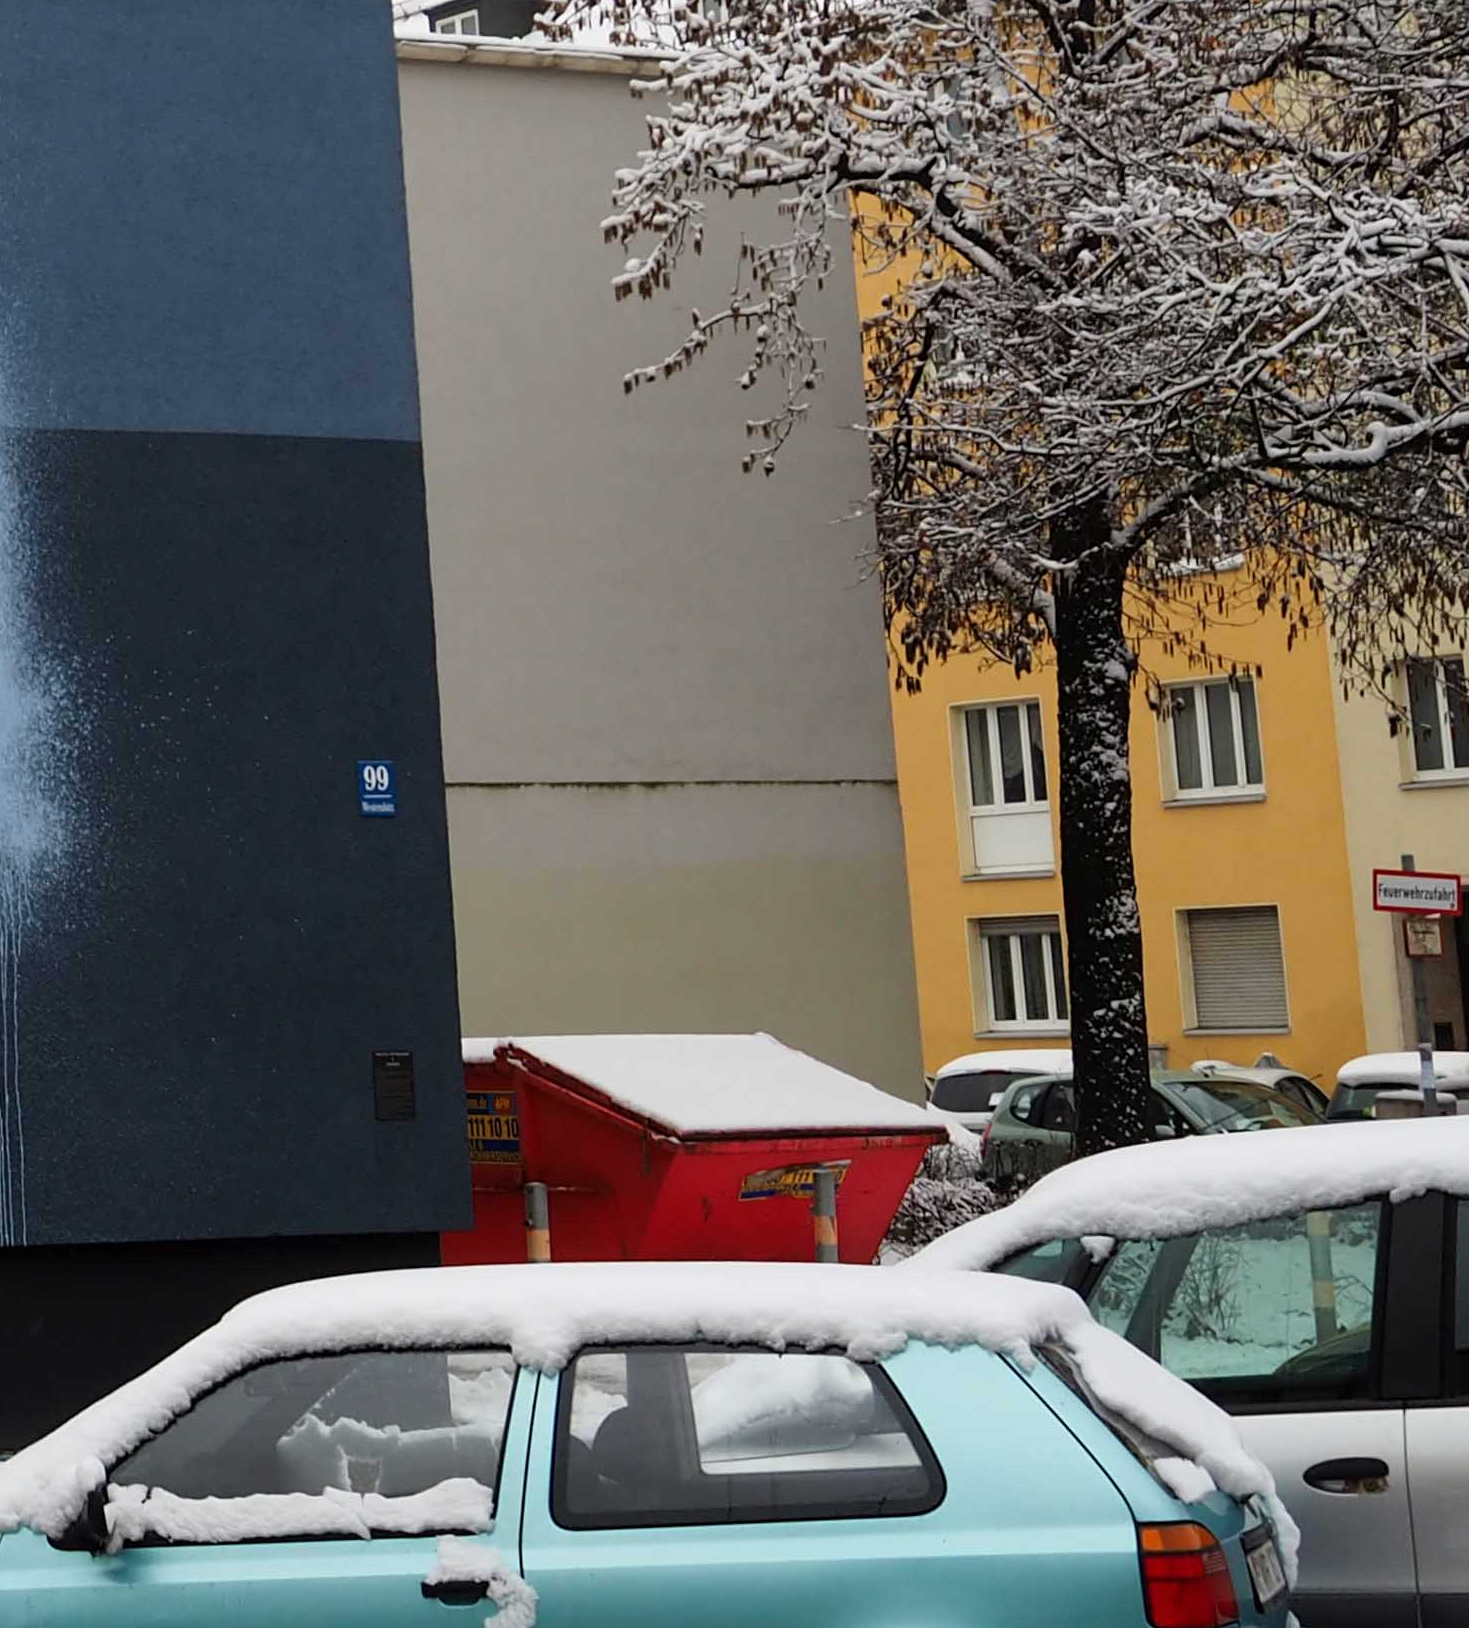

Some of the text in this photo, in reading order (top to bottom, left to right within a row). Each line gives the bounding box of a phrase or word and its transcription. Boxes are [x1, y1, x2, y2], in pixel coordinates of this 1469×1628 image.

[363, 764, 389, 791] 99
[1378, 882, 1456, 902] Feuerwehrzufahrt
[488, 1117, 502, 1138] 10
[505, 1117, 519, 1138] 10
